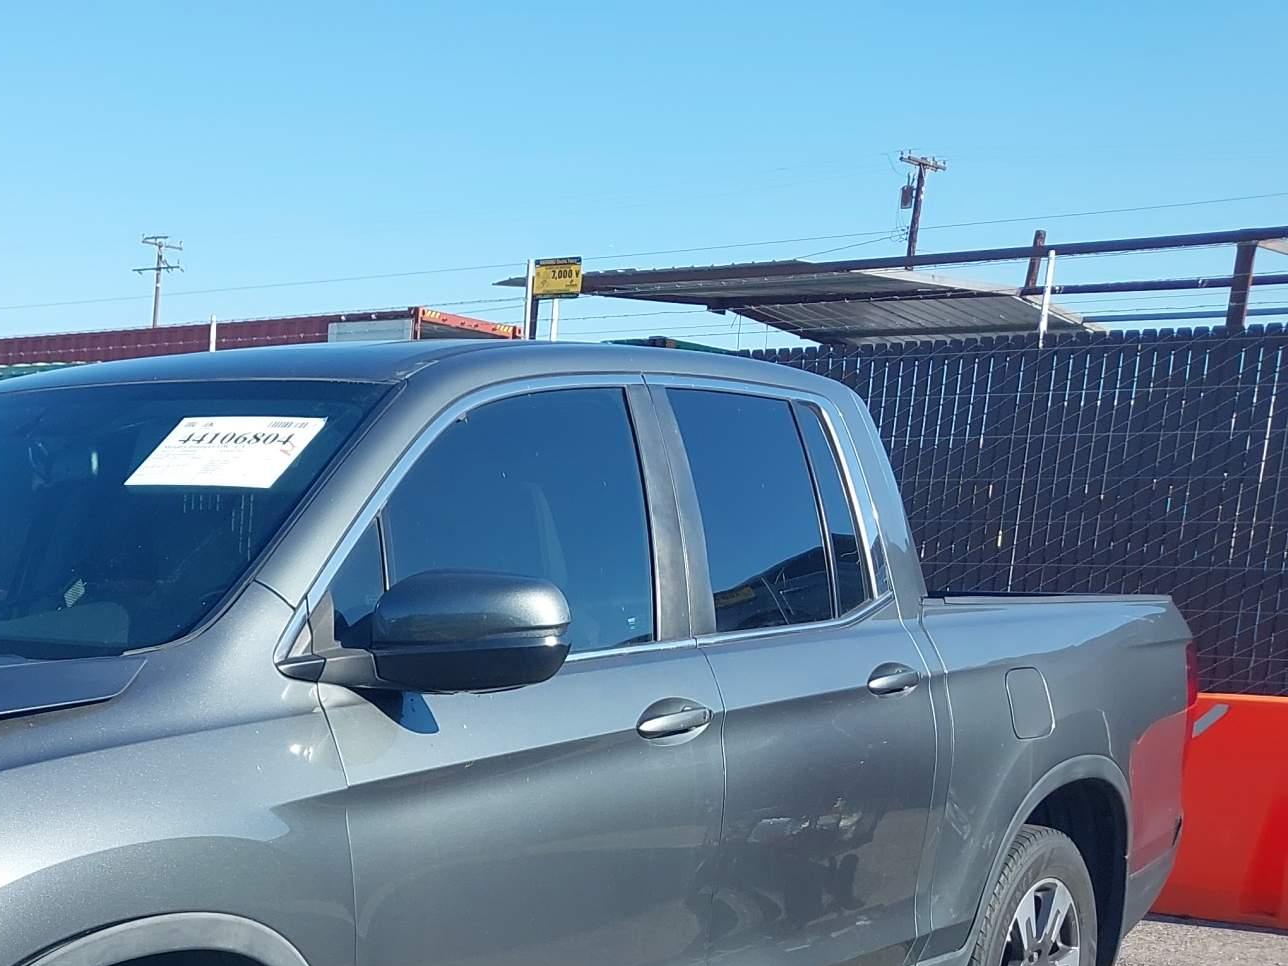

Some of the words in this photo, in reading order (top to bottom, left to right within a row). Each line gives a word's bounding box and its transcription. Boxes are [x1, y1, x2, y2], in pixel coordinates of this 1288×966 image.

[551, 269, 572, 280] 7,000
[574, 269, 580, 278] V
[177, 431, 296, 445] 44106804
